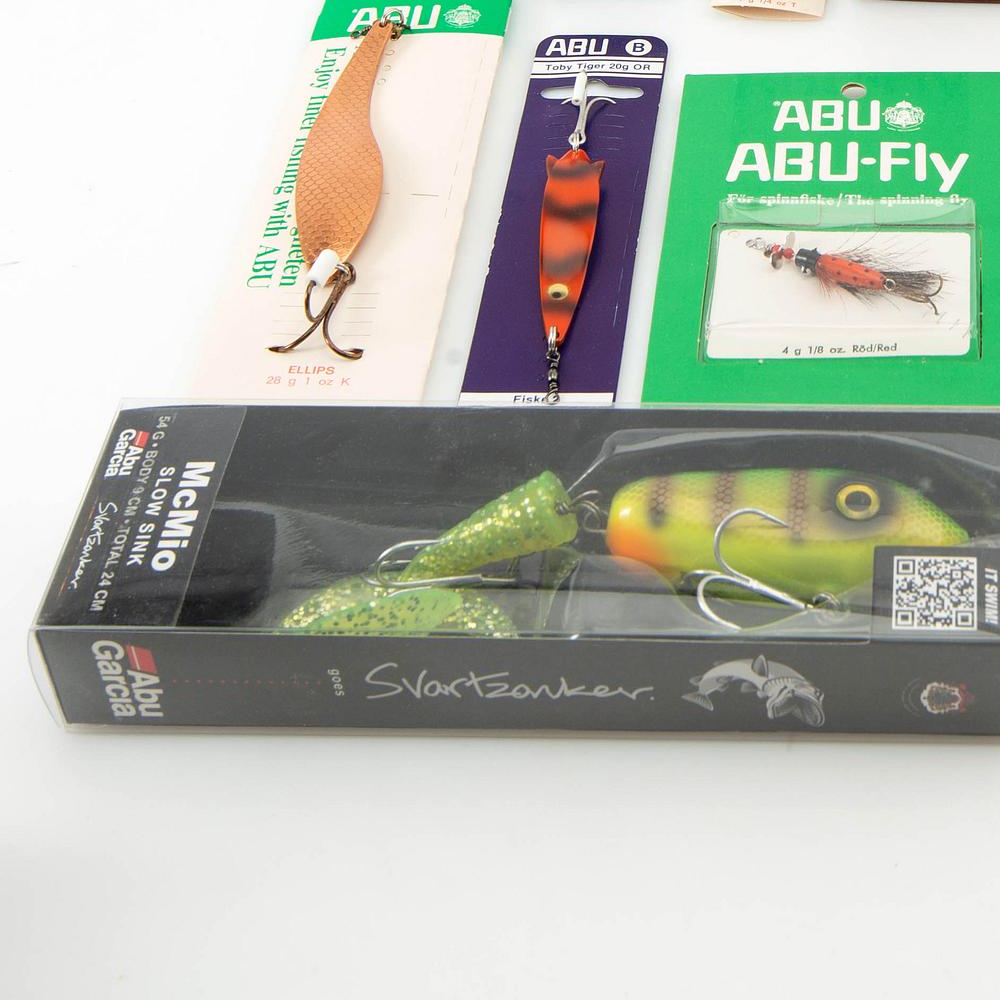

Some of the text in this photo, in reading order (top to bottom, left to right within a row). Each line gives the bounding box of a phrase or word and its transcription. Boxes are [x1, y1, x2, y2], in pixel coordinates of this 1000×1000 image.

[545, 38, 609, 56] ABU
[310, 47, 347, 89] Enjoy
[546, 64, 572, 72] Toby
[577, 62, 605, 72] Tiger
[609, 63, 629, 71] 20g
[773, 100, 880, 132] ABU
[263, 199, 292, 238] with
[879, 193, 944, 207] spinning
[246, 244, 281, 288] ABU
[782, 346, 788, 355] 4
[808, 345, 824, 354] 1/8
[266, 376, 281, 385] 28
[288, 378, 296, 387] g
[341, 377, 350, 386] K
[288, 365, 335, 375] ELLIPS
[104, 428, 137, 478] Garcia
[118, 445, 144, 476] Abu
[90, 415, 171, 611] 54 G BODY 9 CM TOTAL 24 CM
[126, 466, 176, 566] SLOW SINK
[151, 461, 216, 572] McMio
[984, 567, 999, 625] IT SWIM!
[91, 639, 136, 718] Garcia
[127, 669, 164, 718] Abu
[327, 668, 345, 696] goes
